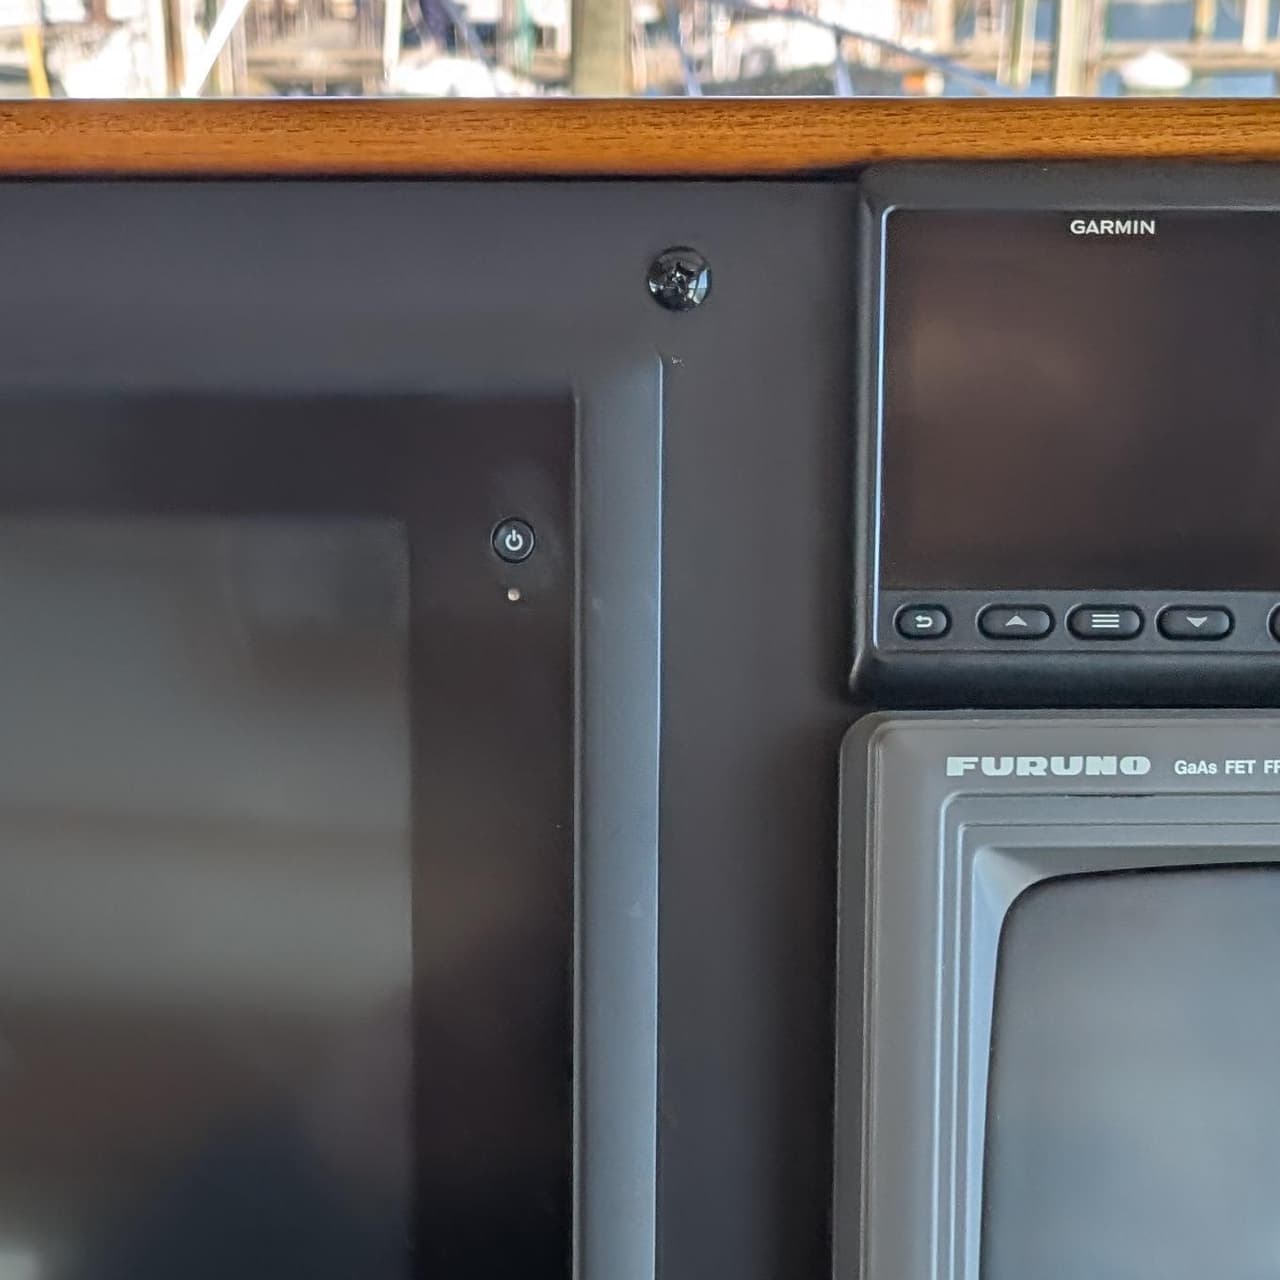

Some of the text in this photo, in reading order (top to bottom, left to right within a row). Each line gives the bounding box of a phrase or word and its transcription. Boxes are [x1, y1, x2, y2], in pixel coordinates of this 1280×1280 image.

[1070, 219, 1156, 236] GARMIN
[946, 756, 1151, 777] FURUNO
[1175, 760, 1217, 775] GaAs
[1225, 760, 1256, 774] FET
